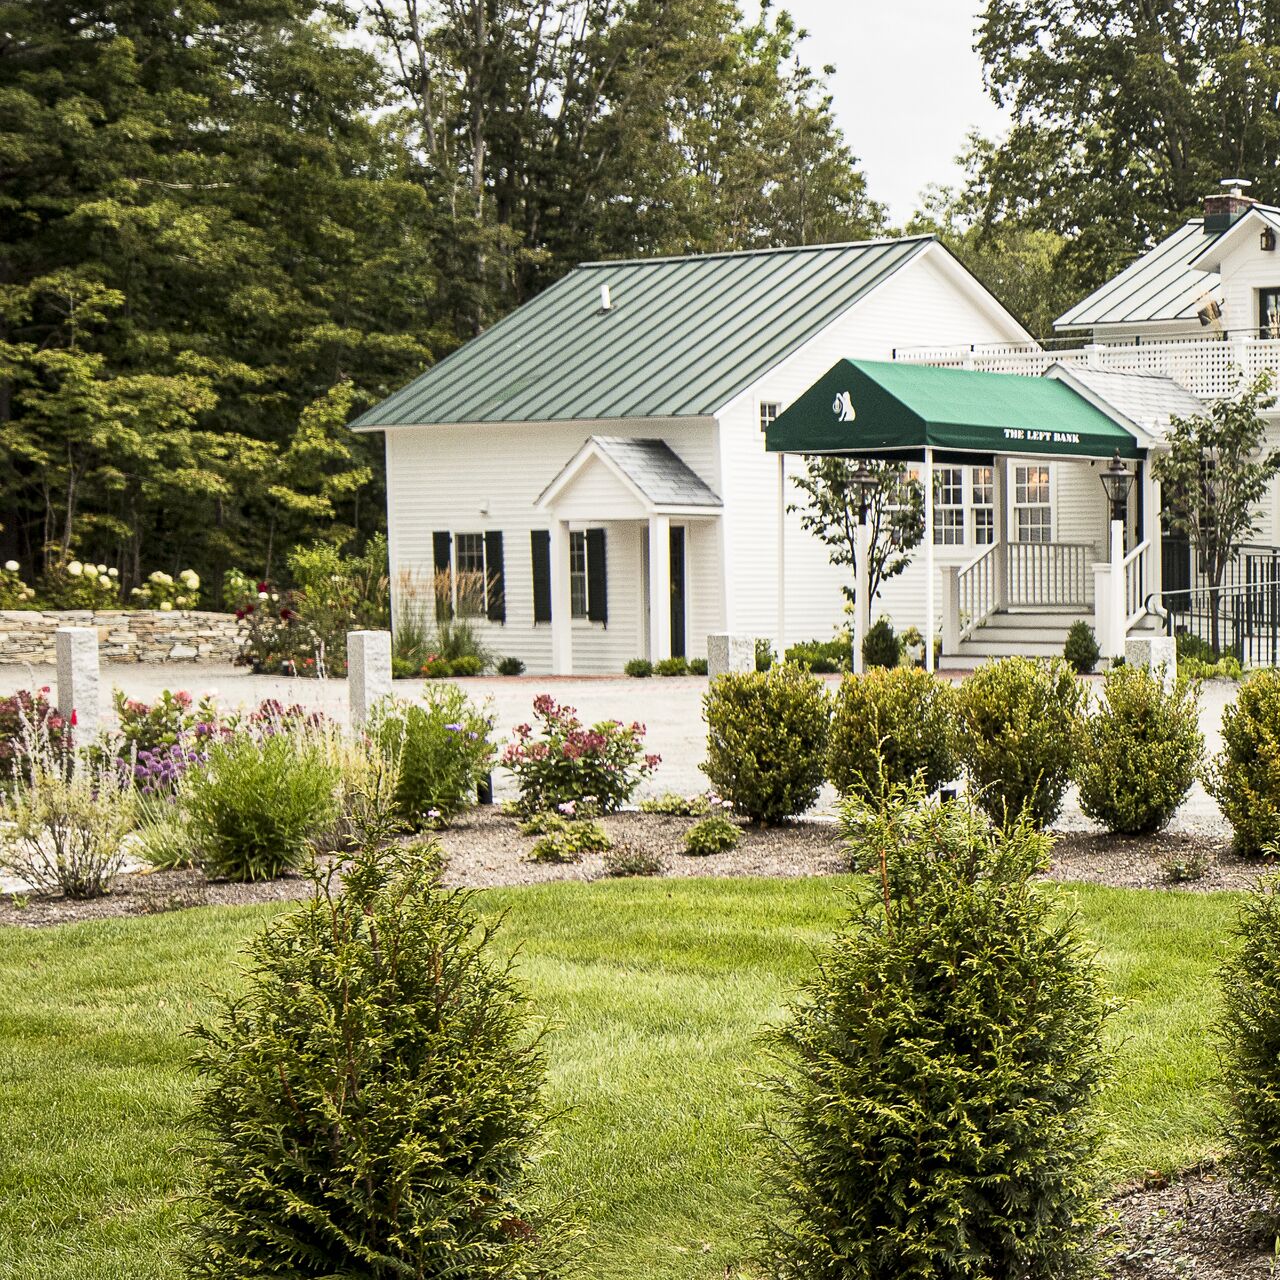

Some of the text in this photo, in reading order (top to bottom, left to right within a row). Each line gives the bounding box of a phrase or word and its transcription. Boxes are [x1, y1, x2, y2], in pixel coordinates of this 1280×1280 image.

[1003, 428, 1080, 444] THE LEFT BANK
